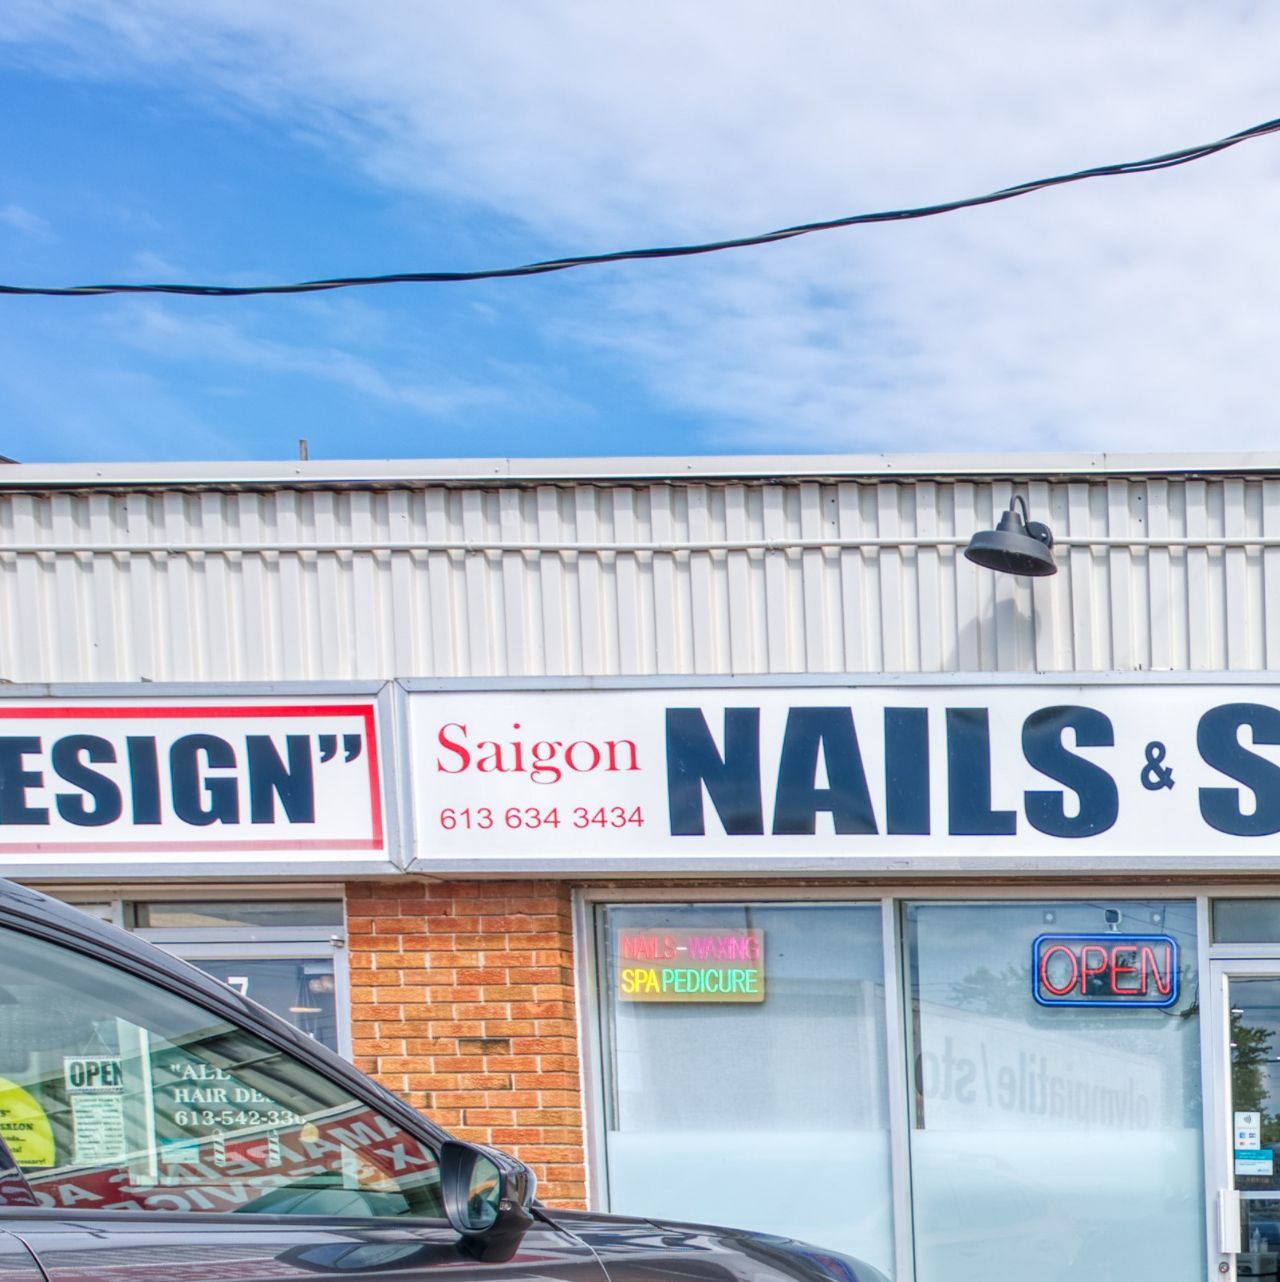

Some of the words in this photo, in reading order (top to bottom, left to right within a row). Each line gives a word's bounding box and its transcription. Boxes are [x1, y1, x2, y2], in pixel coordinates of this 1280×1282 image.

[436, 723, 642, 784] Saigon
[665, 705, 1119, 838] NAILS
[1140, 741, 1175, 791] &
[440, 806, 494, 830] 613
[505, 805, 559, 830] 634
[573, 805, 645, 829] 3434
[621, 968, 660, 993] SPA
[661, 968, 758, 993] PEDICURE
[1040, 945, 1172, 996] OPEN
[174, 1088, 228, 1103] HAIR
